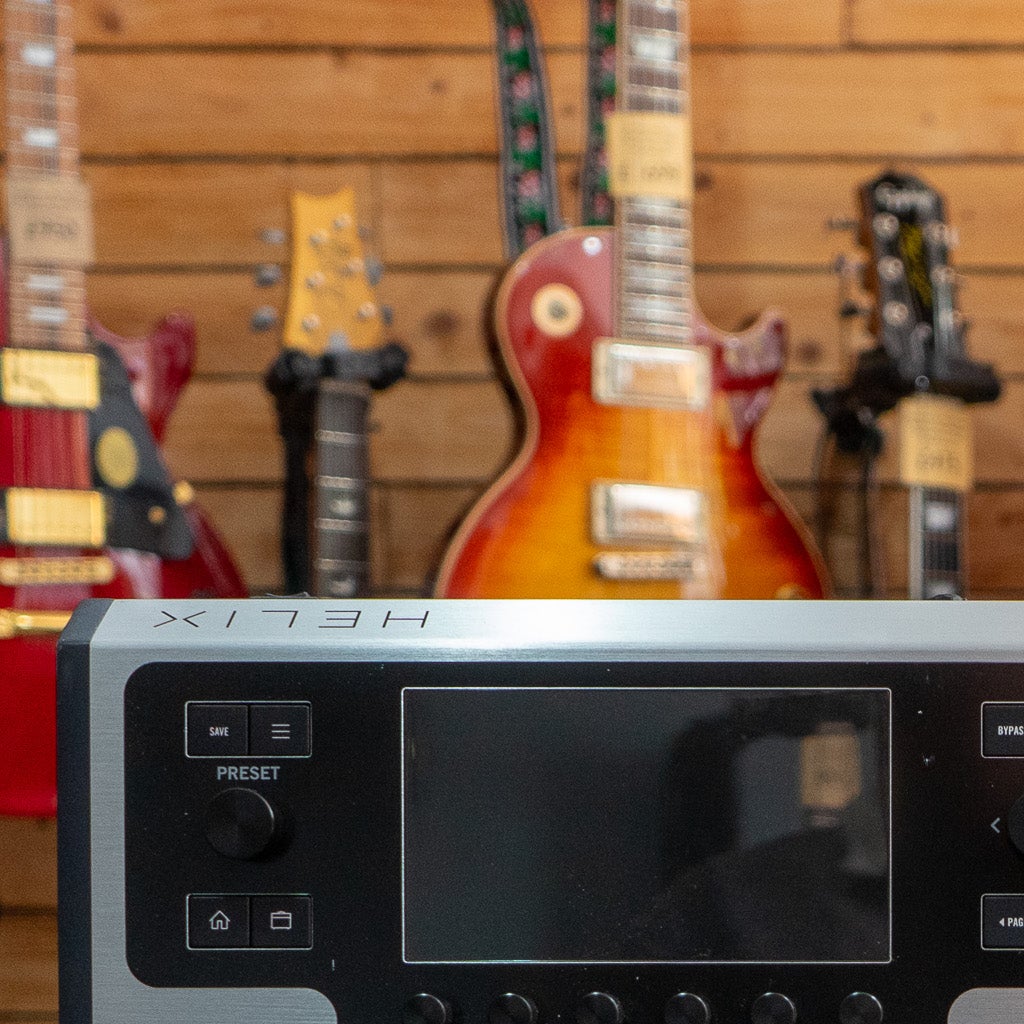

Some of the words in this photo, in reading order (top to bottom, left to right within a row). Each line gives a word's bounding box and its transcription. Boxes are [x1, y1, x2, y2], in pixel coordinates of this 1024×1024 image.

[153, 610, 430, 629] HELIX
[209, 726, 229, 737] SAVE
[216, 766, 281, 781] PRESET
